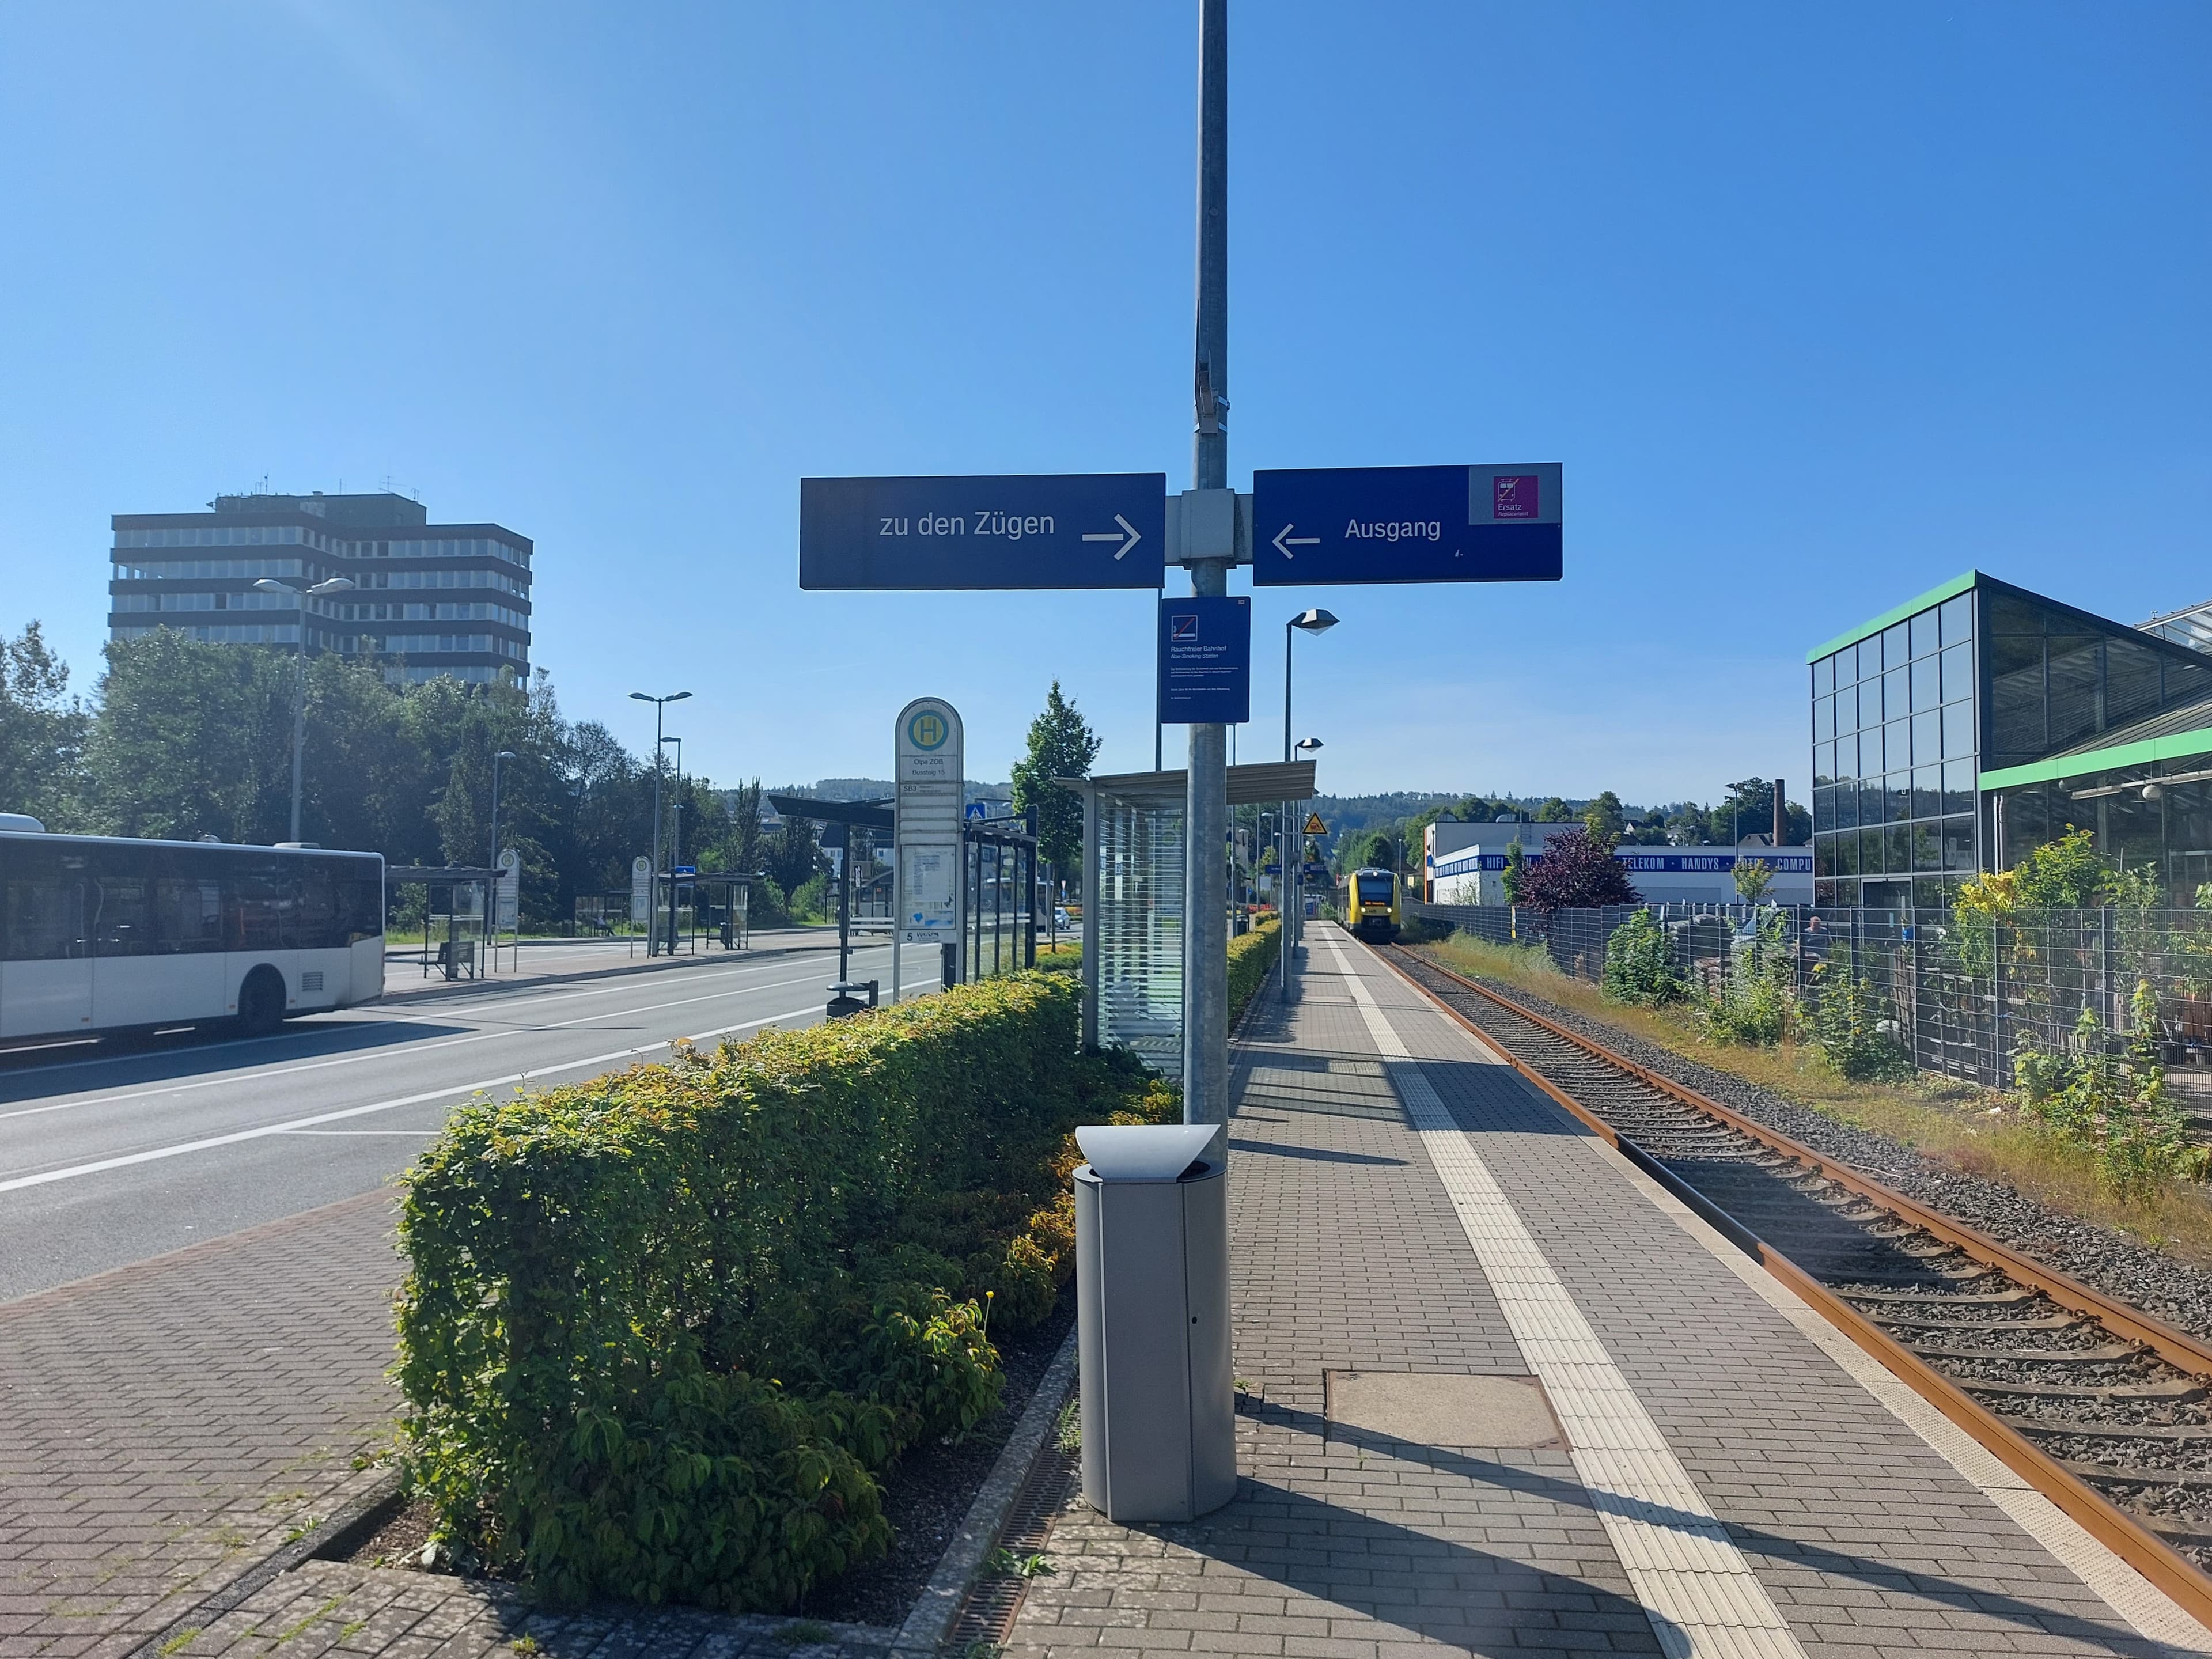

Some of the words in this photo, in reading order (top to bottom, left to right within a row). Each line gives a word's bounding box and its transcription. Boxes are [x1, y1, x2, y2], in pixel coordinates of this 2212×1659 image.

[880, 517, 908, 536] zu
[918, 512, 965, 536] den
[974, 510, 1054, 540] Zügen
[1344, 518, 1440, 542] Ausgang
[921, 718, 937, 743] H
[1486, 857, 1504, 869] HIFI
[1622, 857, 1664, 869] TELEKOM
[1681, 857, 1719, 870] HANDYS
[1777, 858, 1813, 871] COMPU
[907, 932, 913, 941] 5
